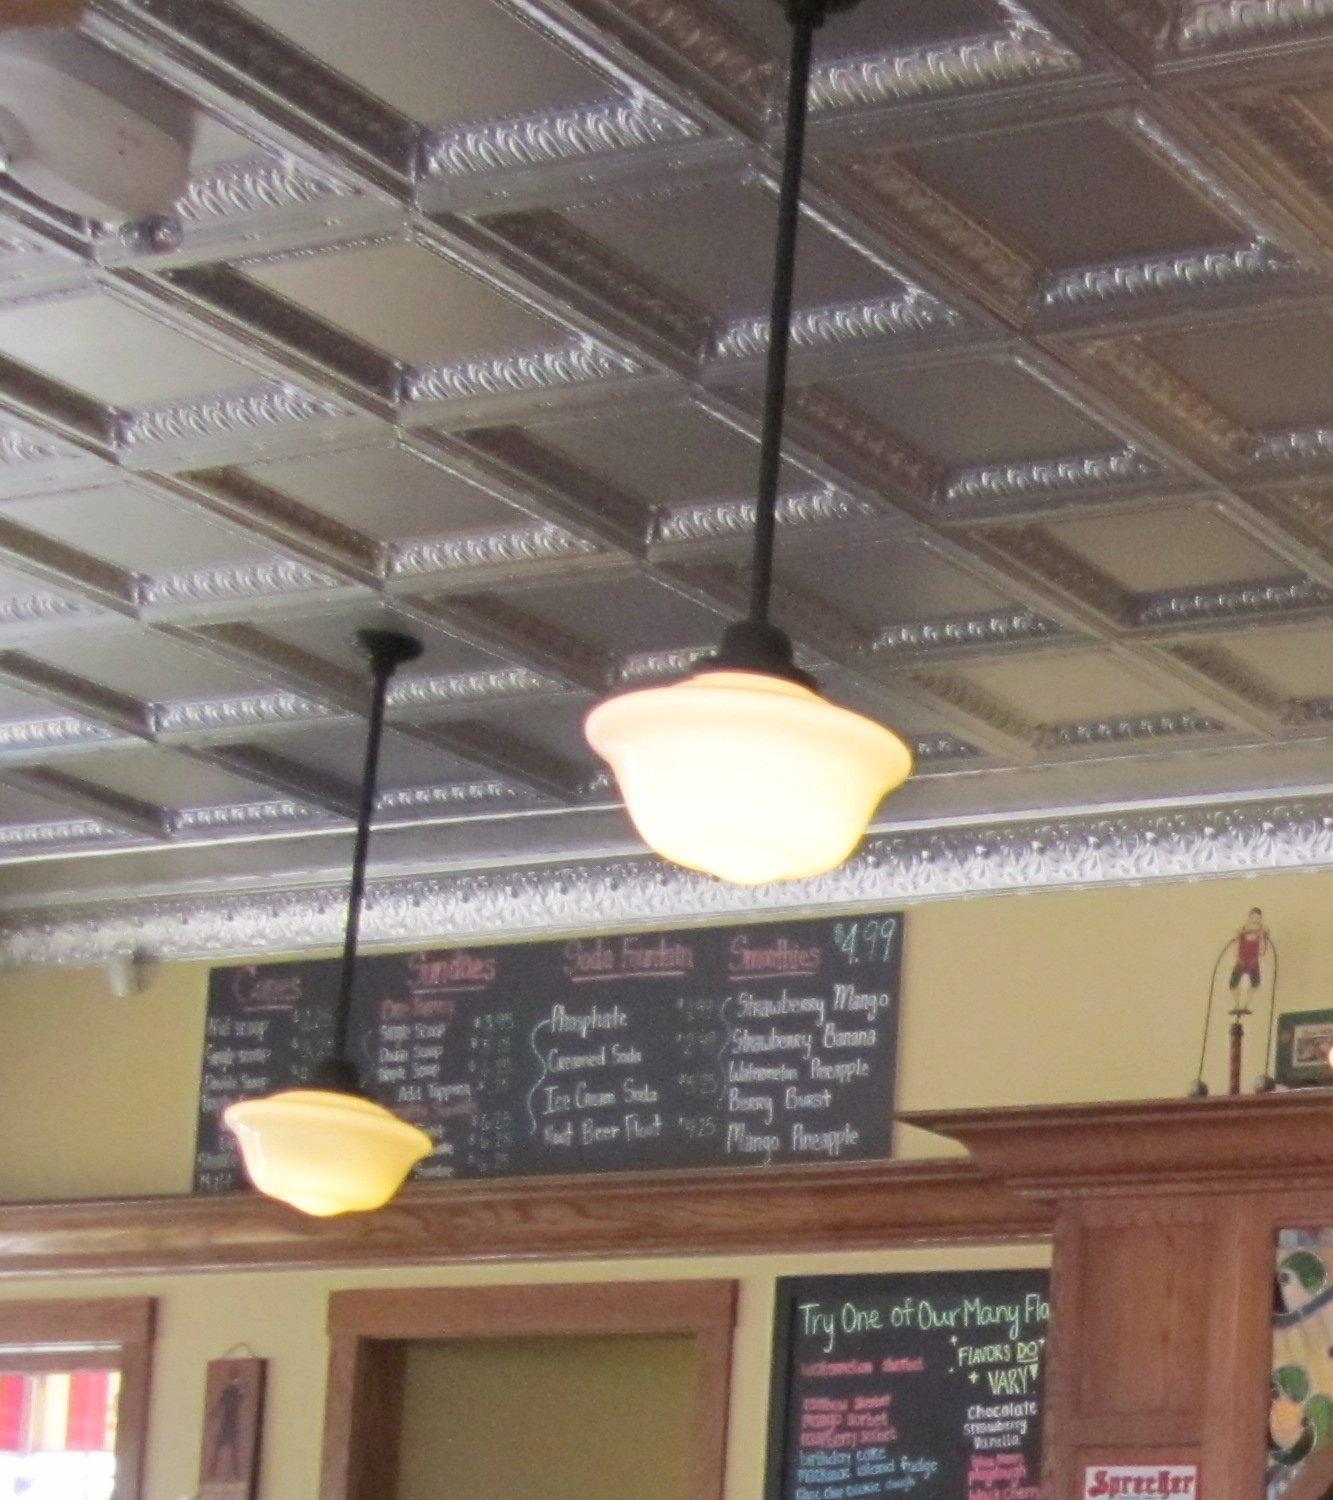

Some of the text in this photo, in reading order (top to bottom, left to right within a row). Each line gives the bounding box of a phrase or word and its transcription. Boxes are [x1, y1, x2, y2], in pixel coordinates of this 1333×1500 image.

[728, 935, 822, 971] Smoothies
[552, 1003, 628, 1038] Phosphate
[738, 983, 889, 1027] Strawberry Mango
[731, 1022, 877, 1059] Strawberry Banana
[811, 1057, 870, 1083] Pineapple
[543, 1086, 571, 1115] Ice
[623, 1077, 658, 1102] Soda
[729, 1086, 832, 1125] Berry Burst
[625, 1114, 663, 1142] Float
[727, 1122, 859, 1168] Mango Pineapple
[799, 1303, 835, 1353] Try
[842, 1302, 883, 1333] One
[890, 1298, 915, 1327] of
[918, 1300, 962, 1331] Our
[962, 1297, 1020, 1340] Many
[1017, 1341, 1039, 1363] DO
[968, 1401, 1037, 1420] Chocolate
[974, 1434, 1020, 1449] Vanilla
[1087, 1470, 1194, 1500] Sprecher
